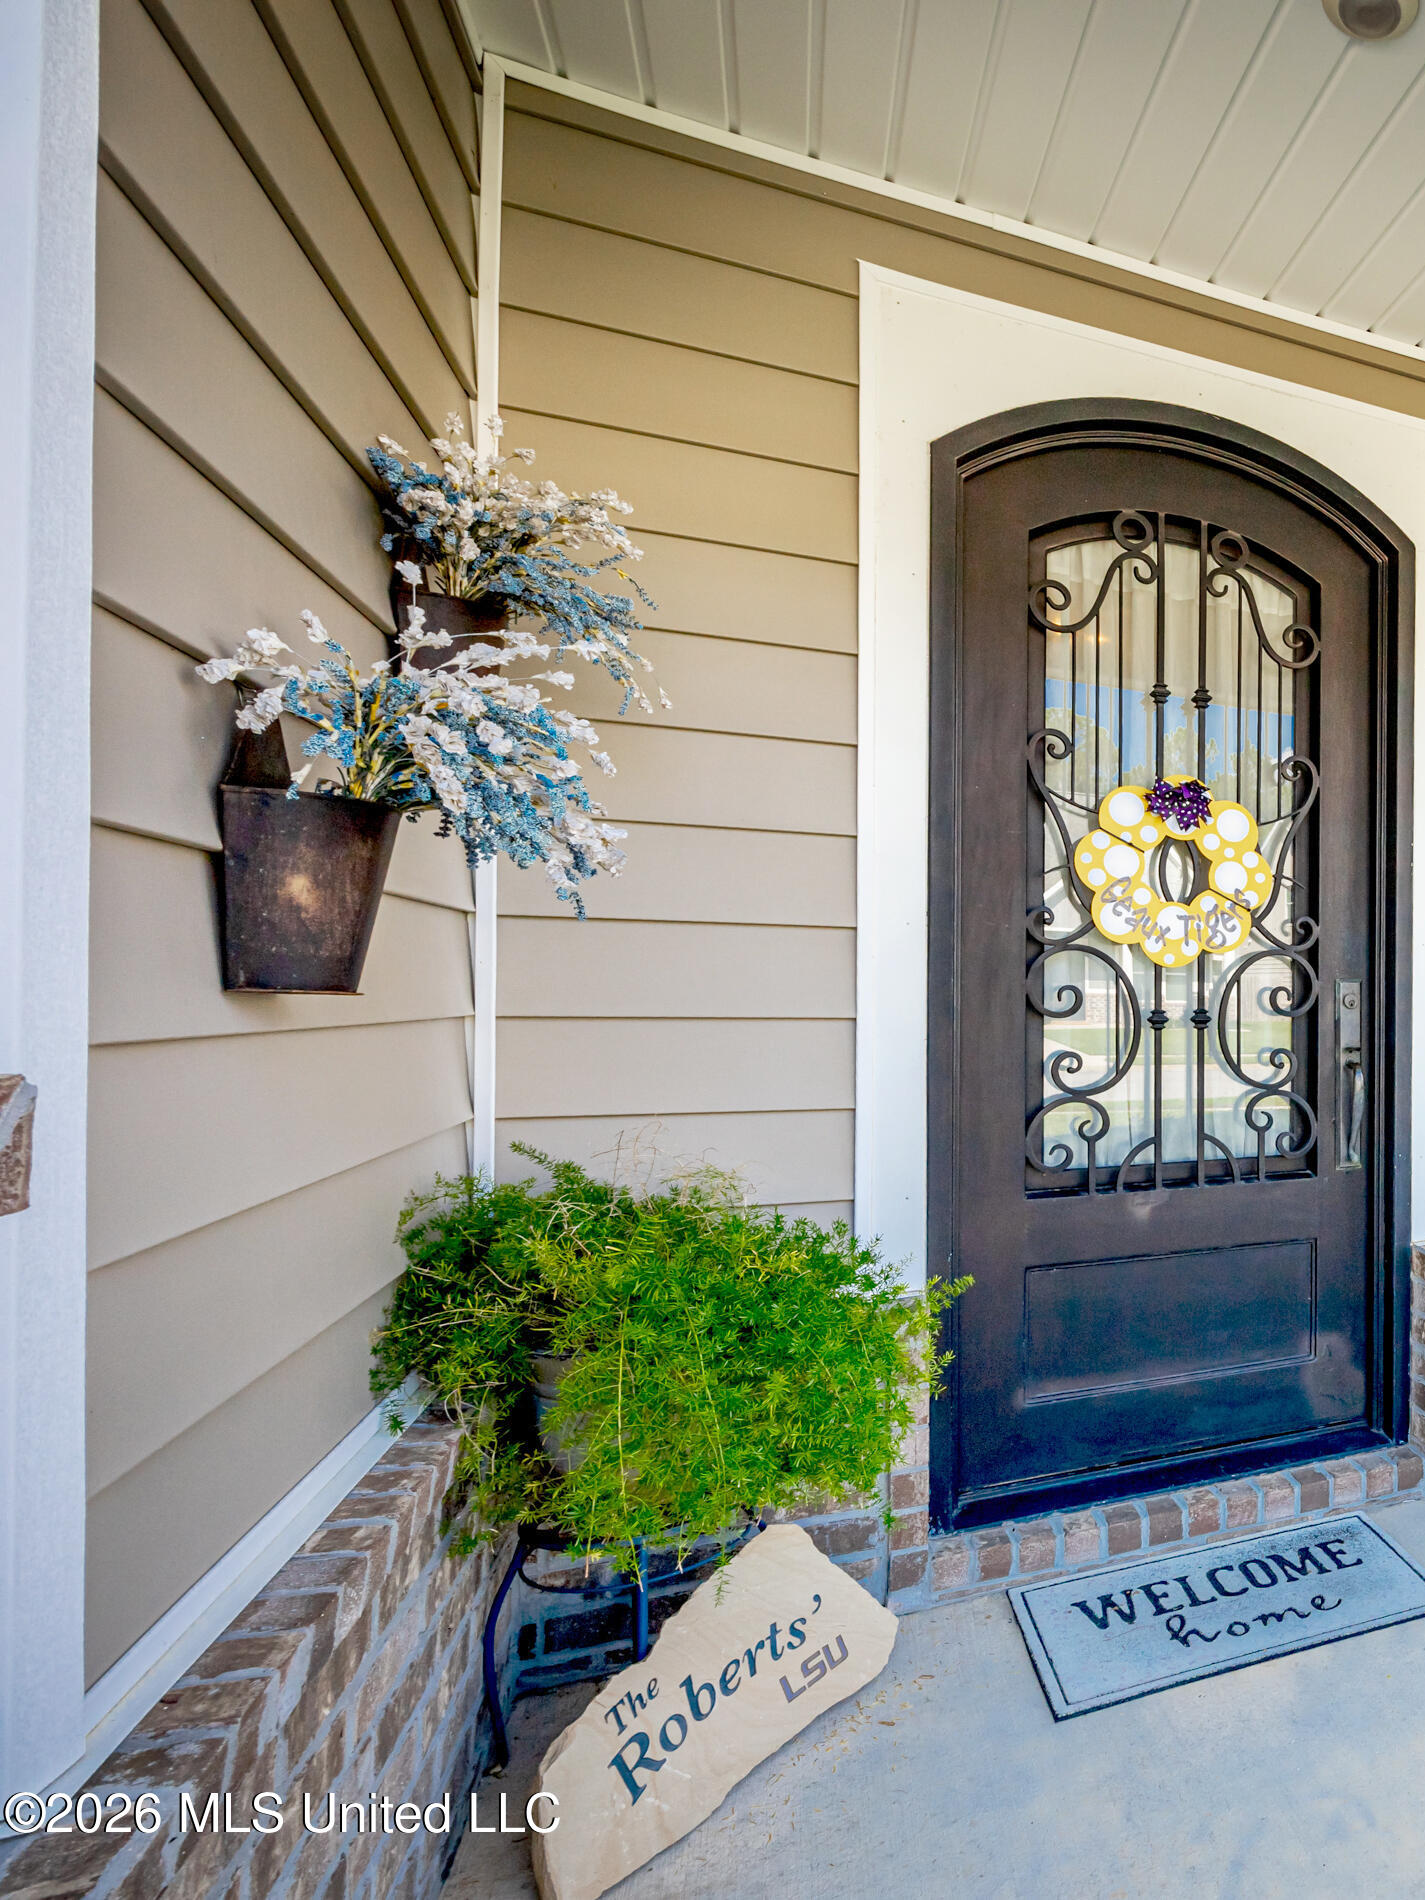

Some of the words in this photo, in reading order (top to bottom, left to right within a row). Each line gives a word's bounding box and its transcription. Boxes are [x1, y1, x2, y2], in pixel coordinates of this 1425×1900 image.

[1176, 888, 1252, 950] Tigers
[1070, 1538, 1364, 1631] WELCOME
[1165, 1593, 1342, 1648] home
[778, 1634, 850, 1704] LSU
[603, 1676, 660, 1737] The
